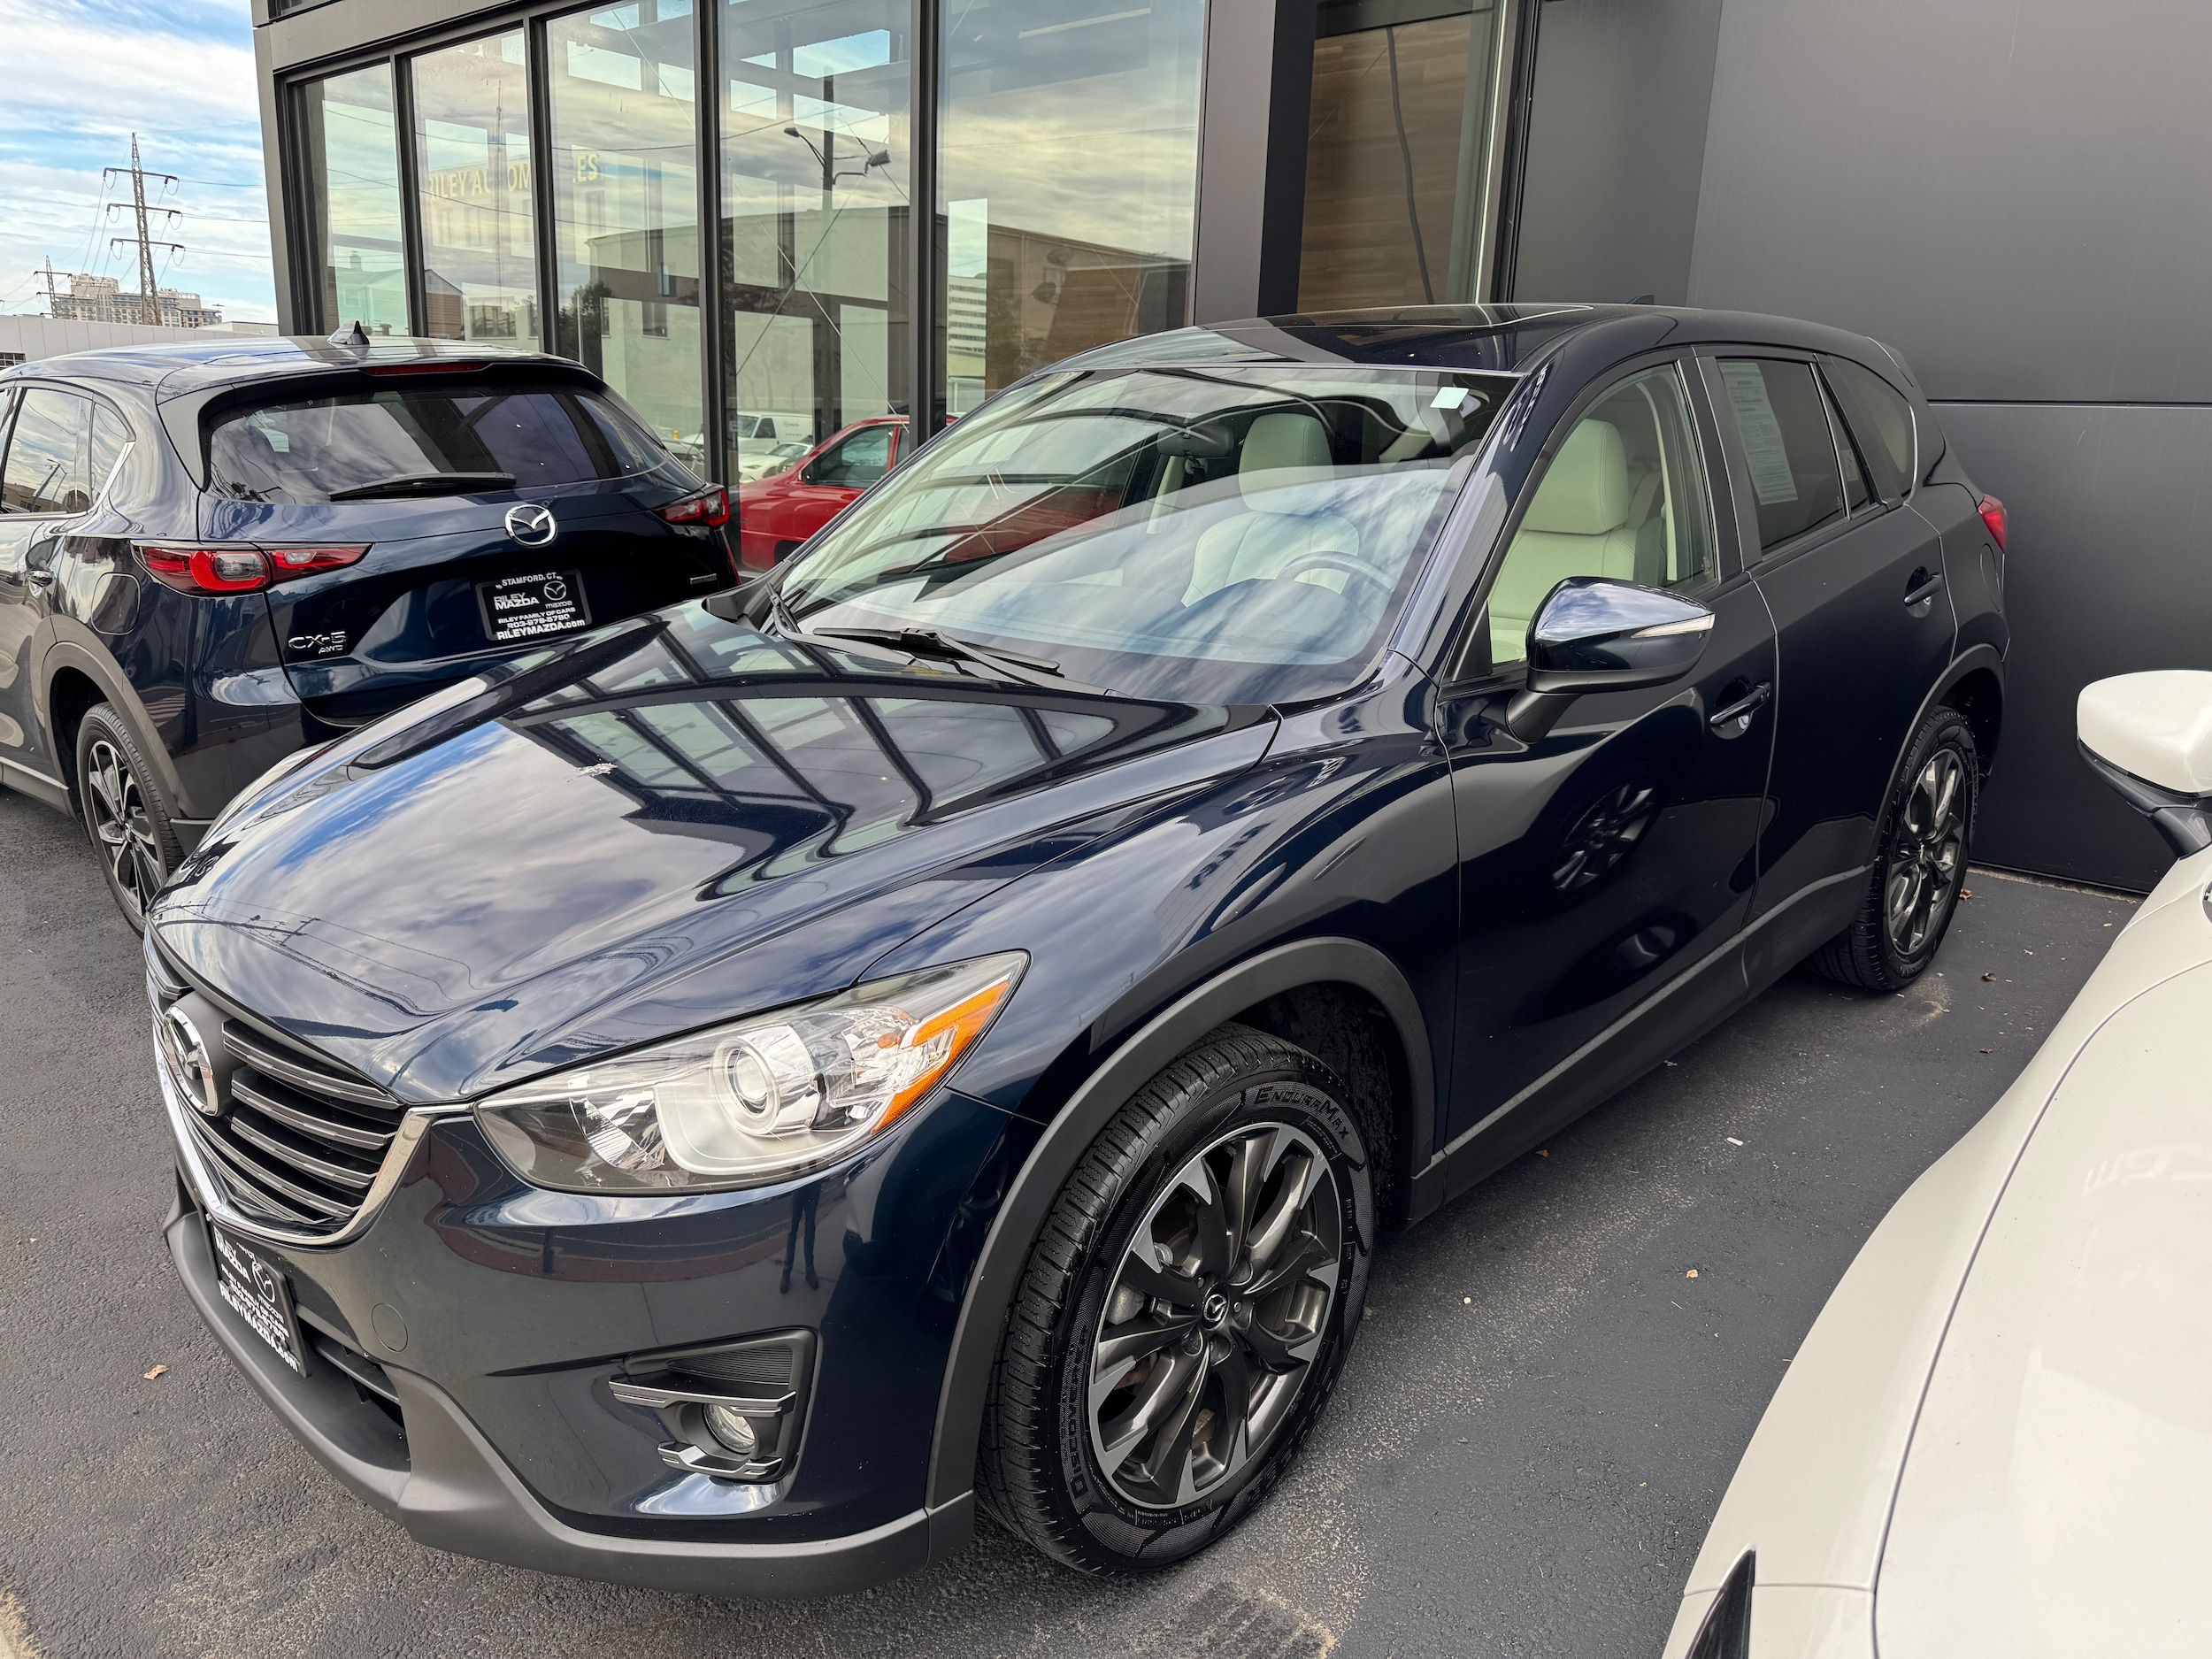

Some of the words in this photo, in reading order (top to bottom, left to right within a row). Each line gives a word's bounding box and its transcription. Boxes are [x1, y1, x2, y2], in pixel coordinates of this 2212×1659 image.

[494, 593, 526, 603] RILEY
[495, 597, 540, 611] MAZDA
[496, 619, 586, 641] RILEYMAZDA.com
[288, 631, 346, 649] CX-5
[319, 645, 343, 655] AWD
